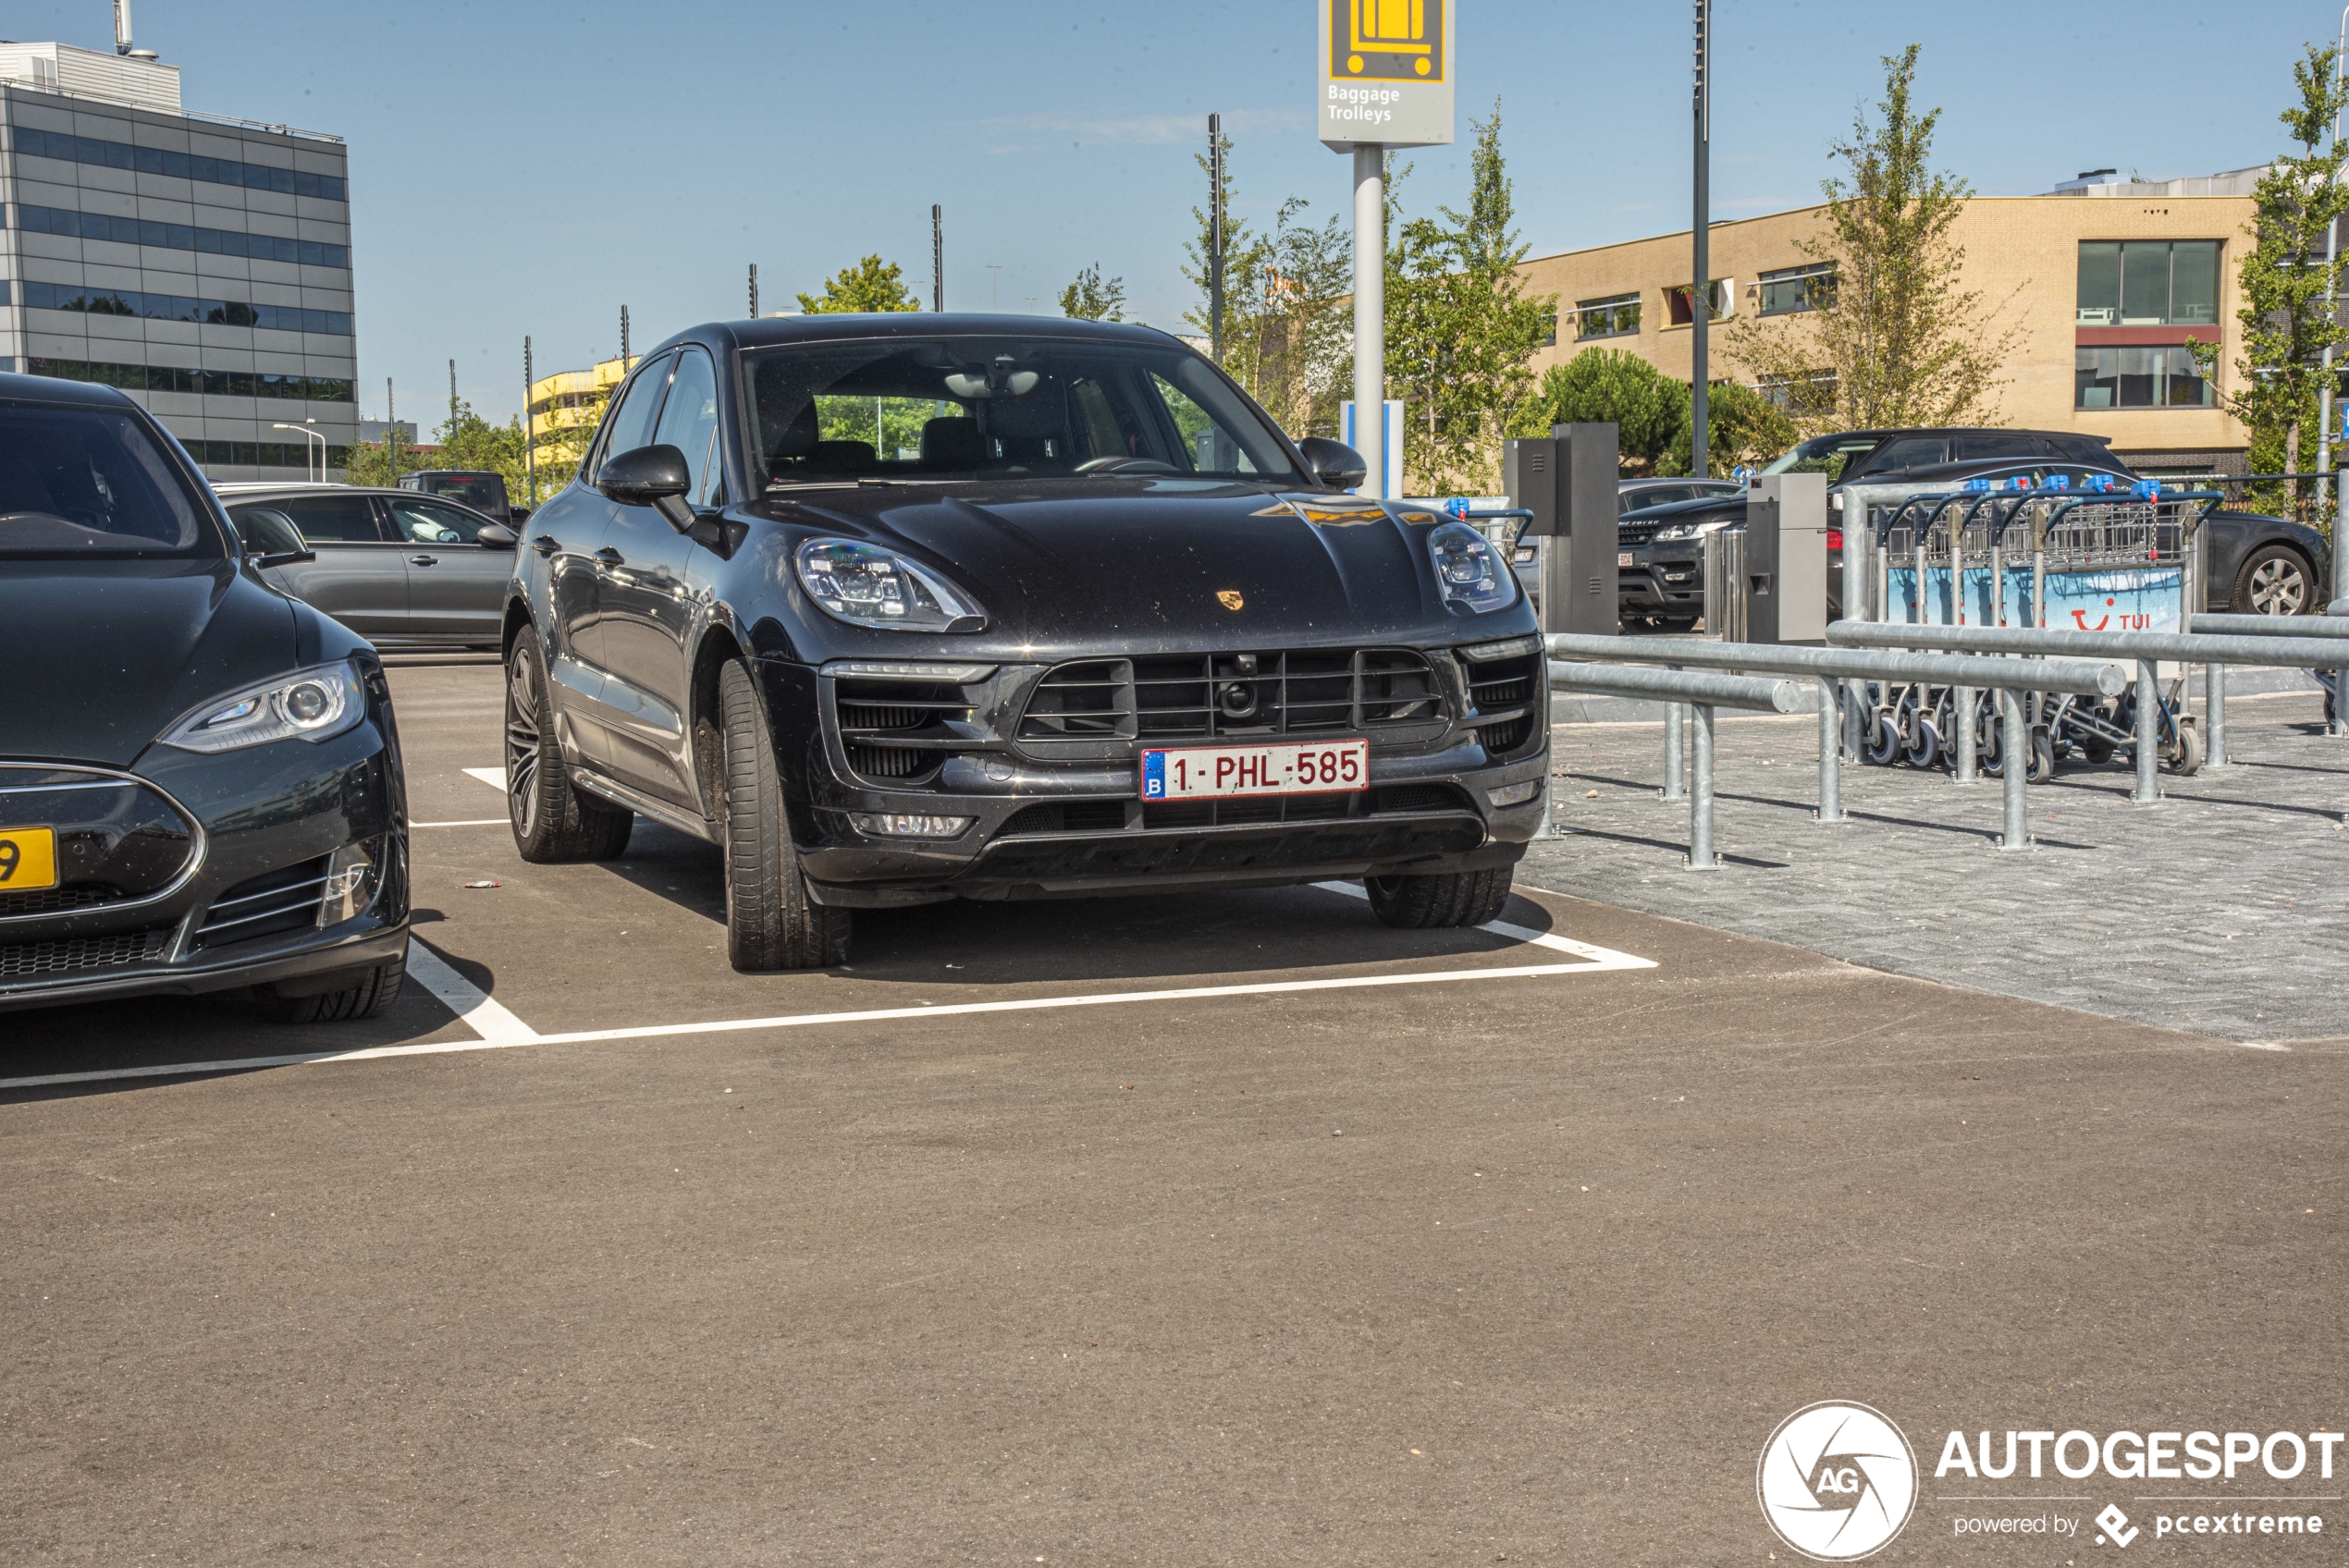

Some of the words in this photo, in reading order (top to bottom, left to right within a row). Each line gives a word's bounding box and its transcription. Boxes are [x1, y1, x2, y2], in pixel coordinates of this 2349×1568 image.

[1328, 84, 1400, 105] Baggage
[1327, 104, 1392, 125] Trolleys
[2119, 613, 2150, 631] TUI
[1174, 749, 1359, 791] 1-PHL-585
[1148, 778, 1162, 795] B
[0, 839, 21, 882] 9
